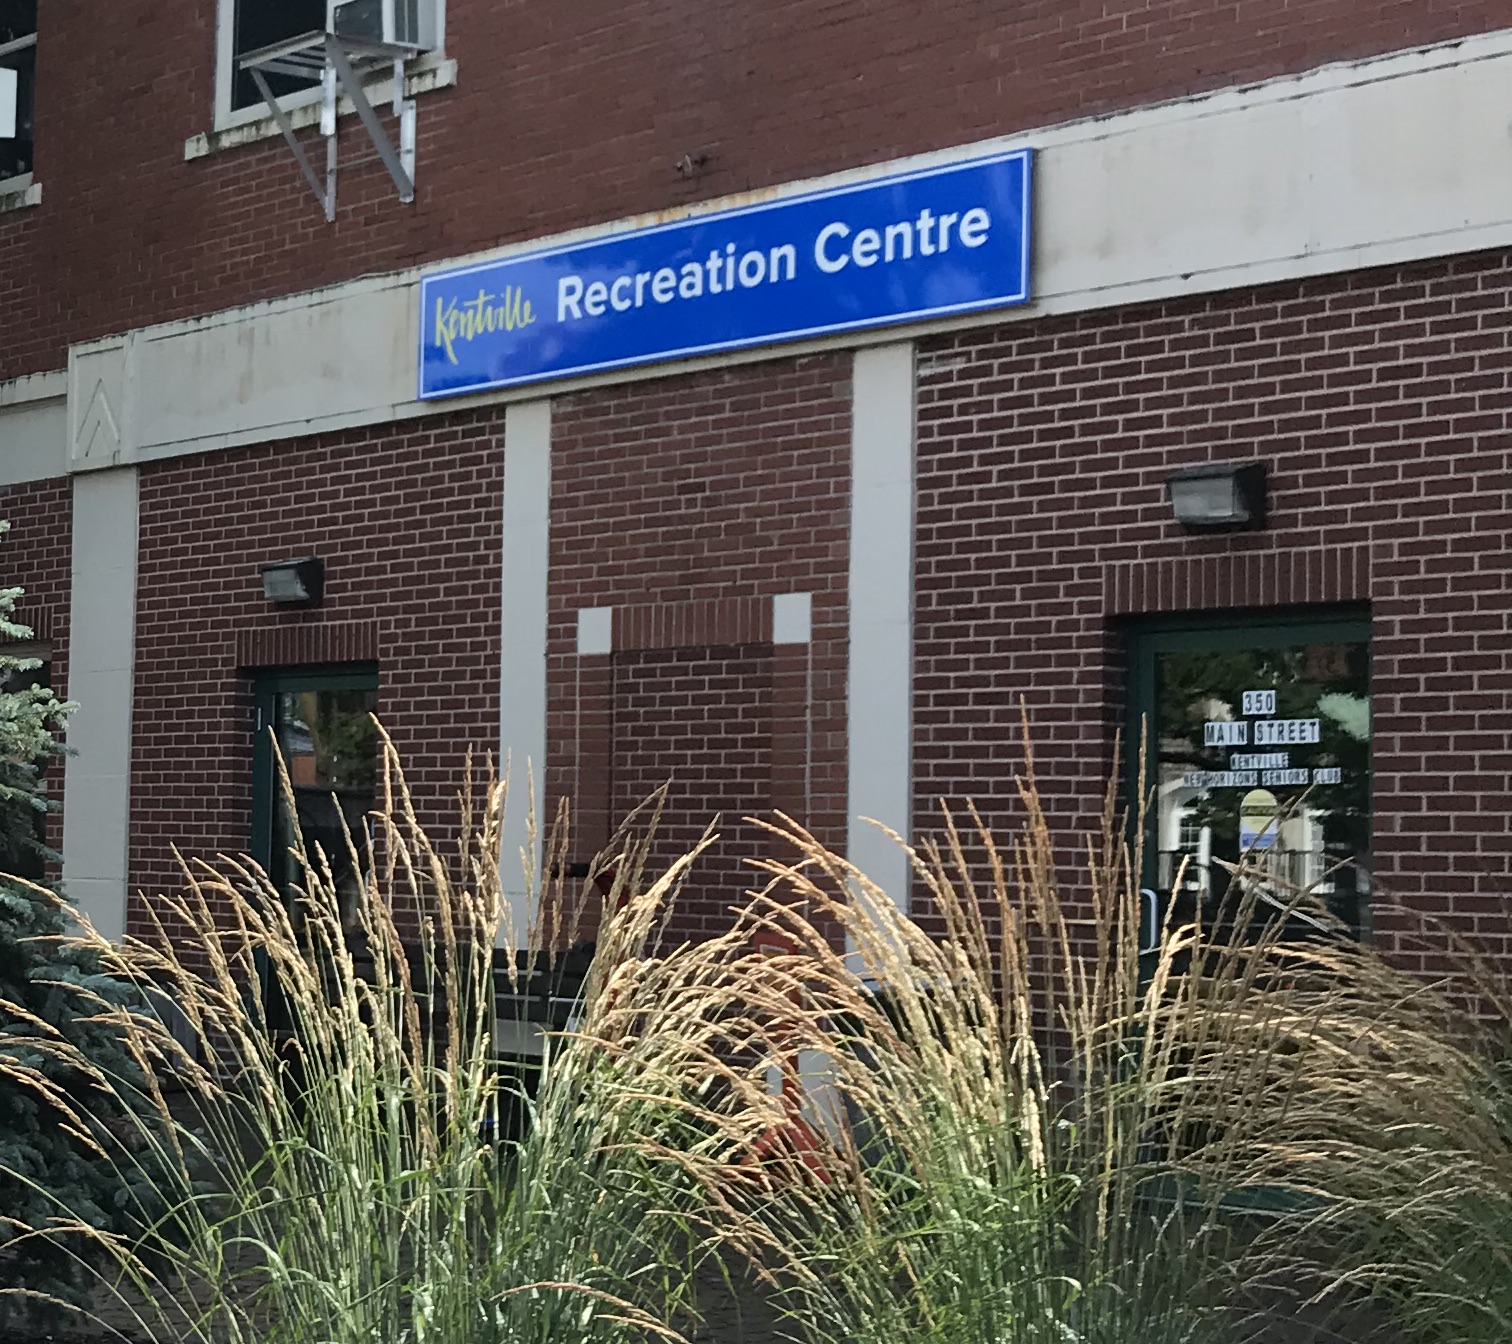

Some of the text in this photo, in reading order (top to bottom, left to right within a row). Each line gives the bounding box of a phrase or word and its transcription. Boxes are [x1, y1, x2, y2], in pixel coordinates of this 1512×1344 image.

[434, 207, 991, 365] Kentville Recreation Centre
[1244, 693, 1273, 712] 350
[1206, 721, 1317, 743] MAIN STREET
